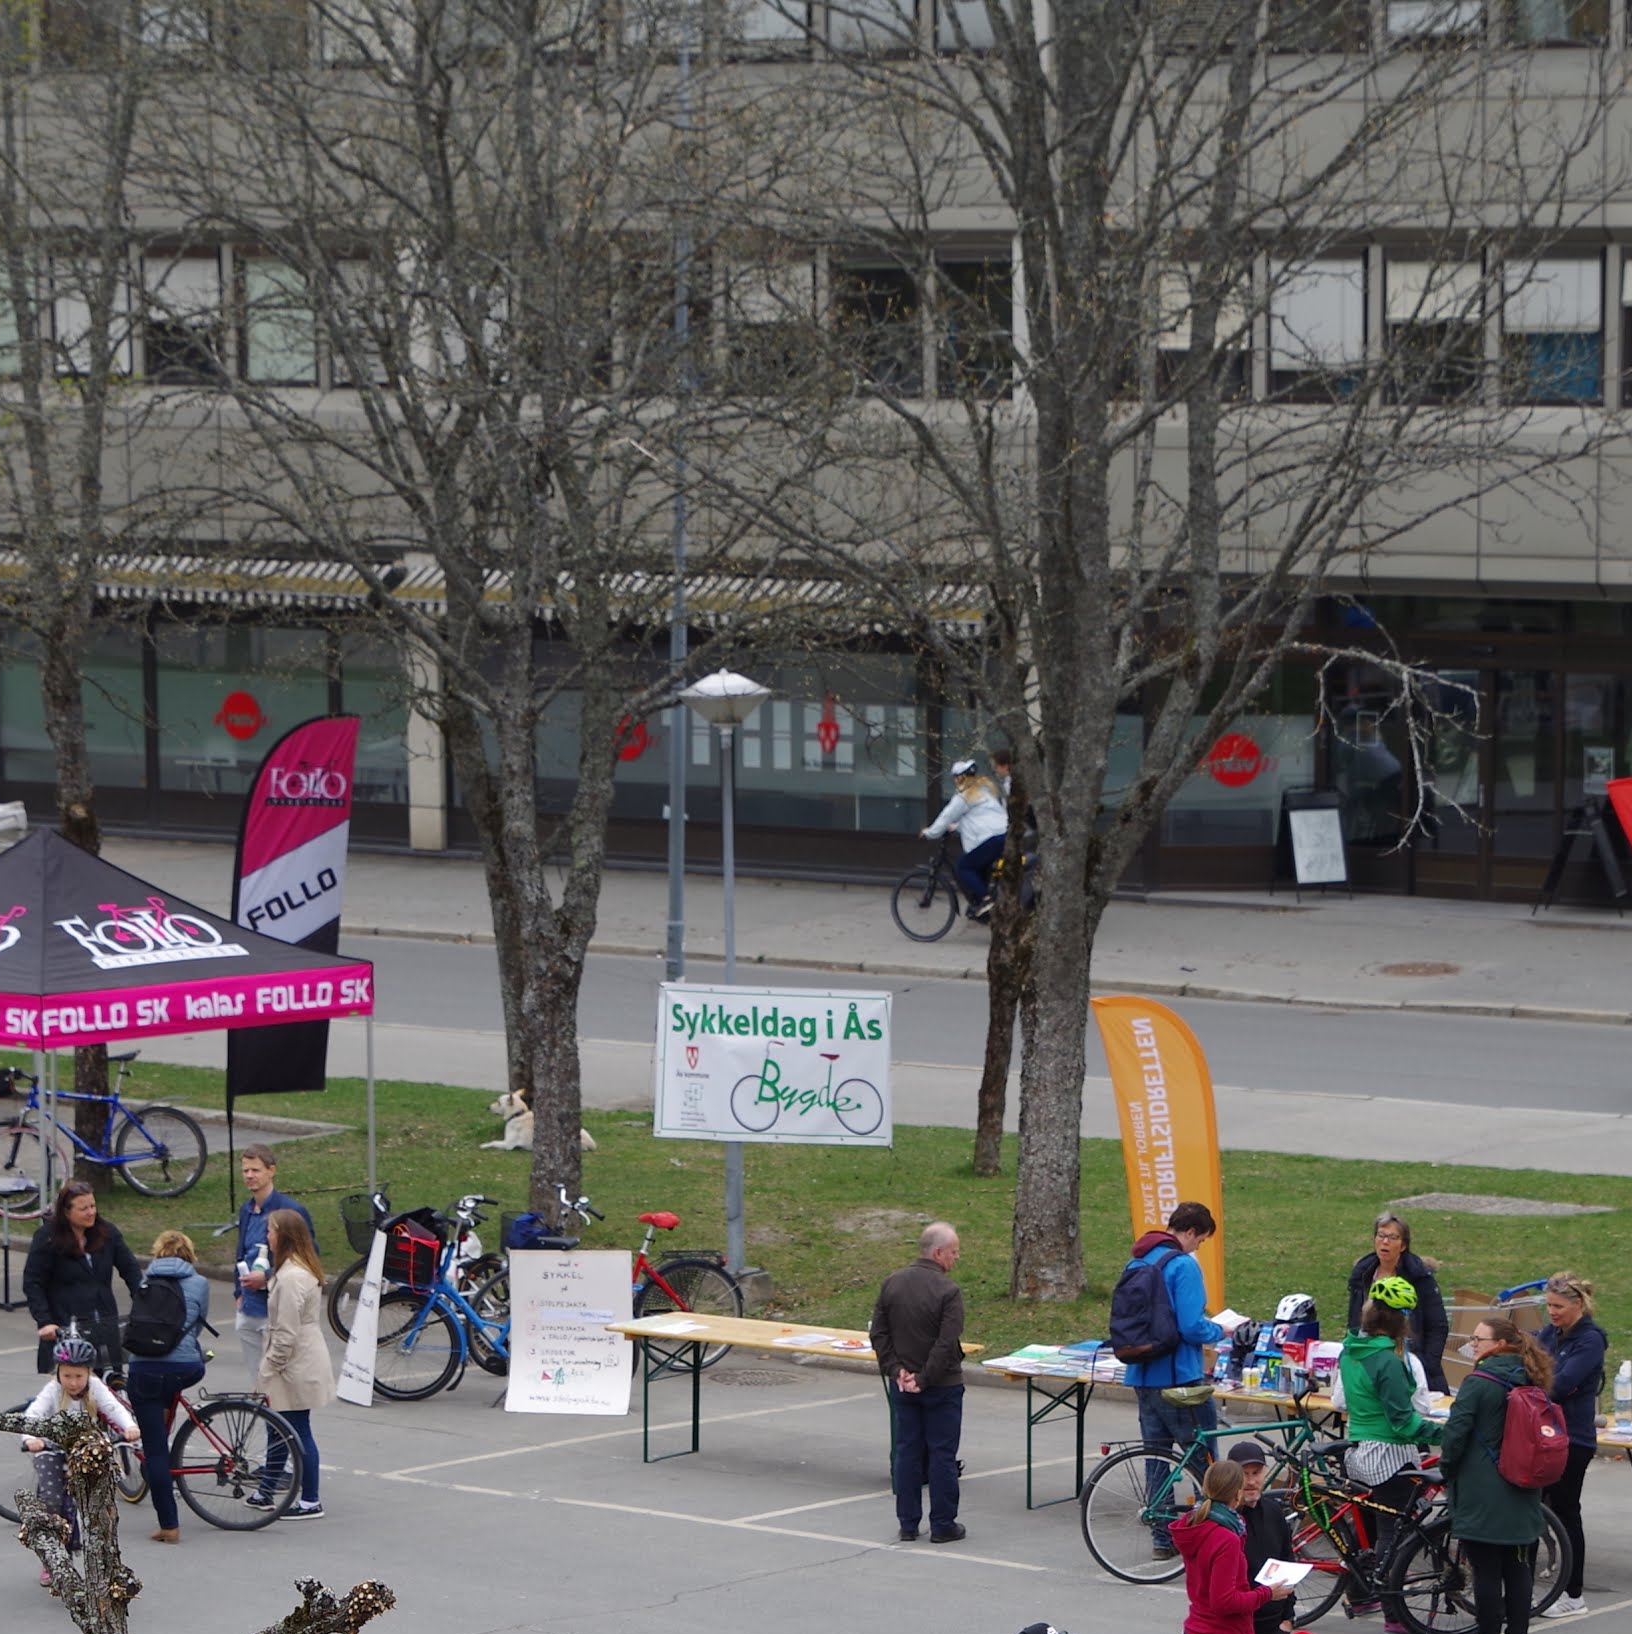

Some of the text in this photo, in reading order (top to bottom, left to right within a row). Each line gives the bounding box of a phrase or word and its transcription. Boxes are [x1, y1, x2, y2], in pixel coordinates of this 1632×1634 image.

[245, 866, 339, 932] FOLLO
[4, 1007, 39, 1037] SK
[40, 976, 371, 1037] FOLLO SK kalas FOLLO SK
[671, 1002, 884, 1048] Sykkeldag i Ås
